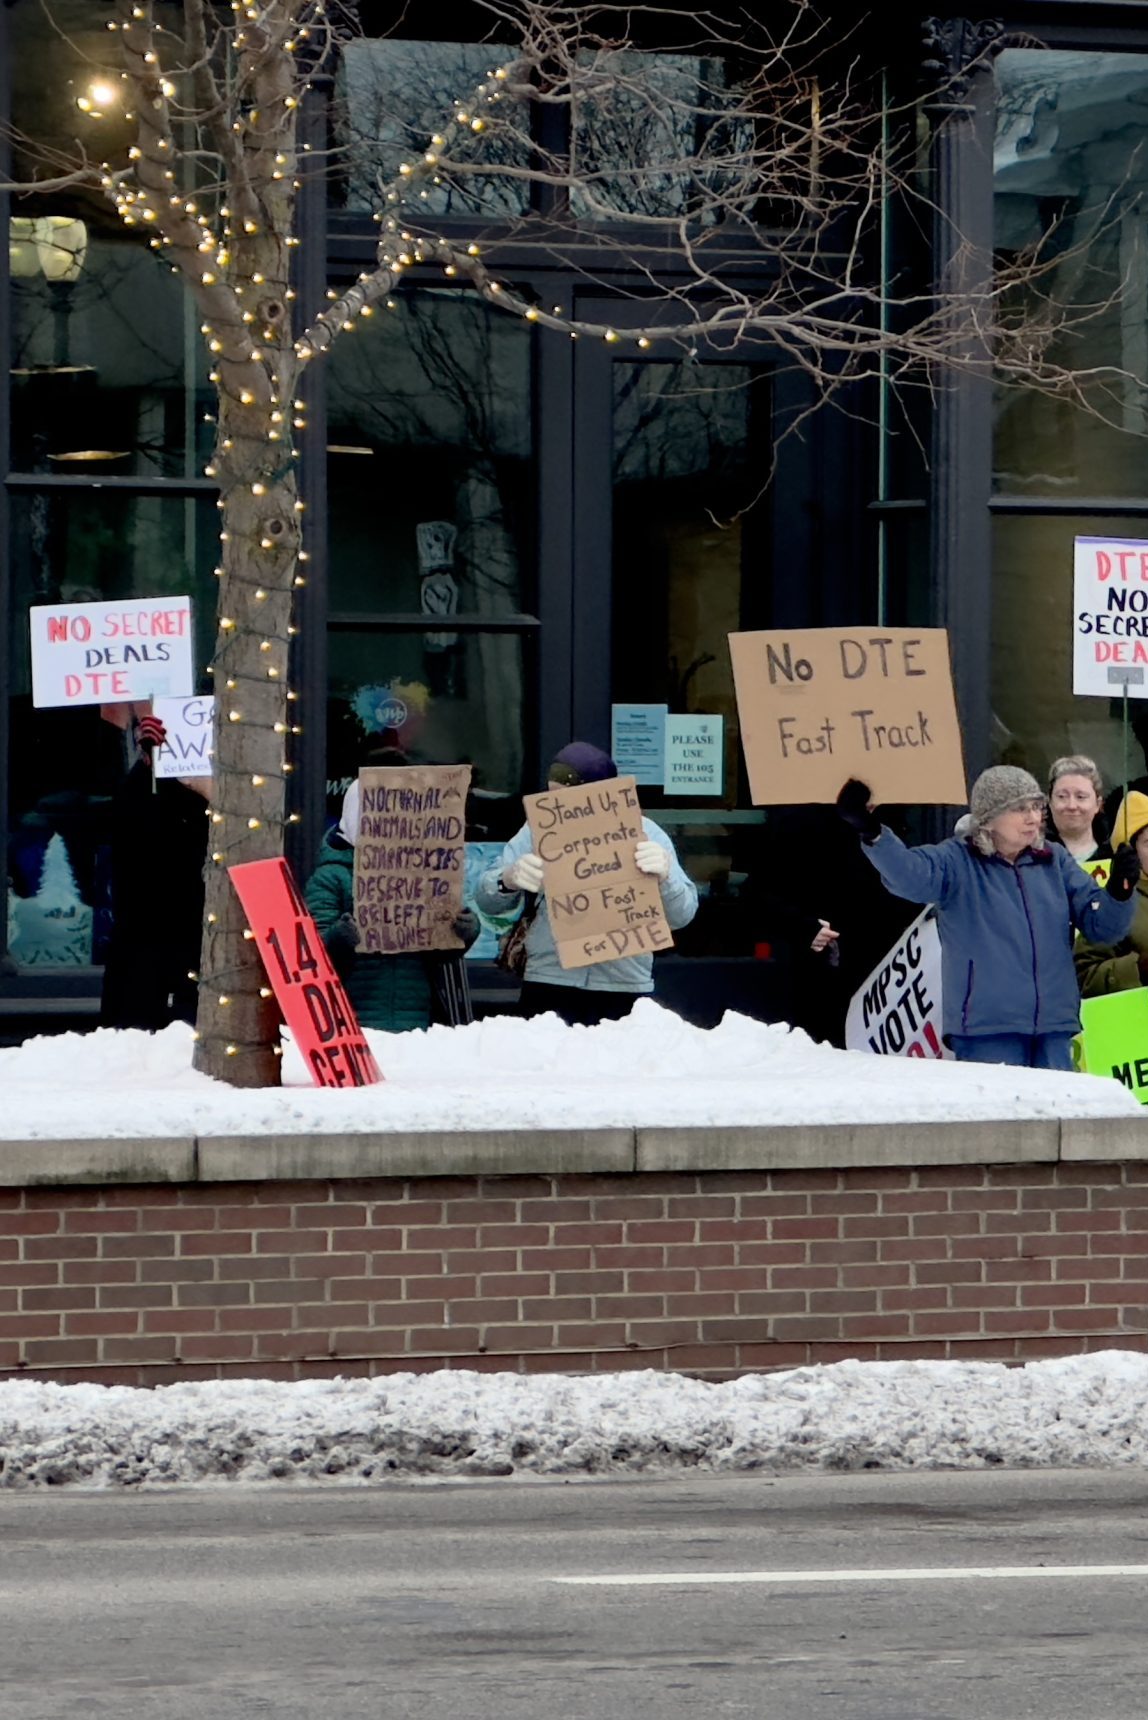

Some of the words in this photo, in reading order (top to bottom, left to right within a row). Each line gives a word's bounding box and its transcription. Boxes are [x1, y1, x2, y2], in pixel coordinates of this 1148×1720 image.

[1107, 587, 1148, 612] NO
[47, 615, 92, 643] NO
[102, 608, 189, 637] SECRET
[85, 641, 171, 669] DEALS
[766, 643, 813, 684] No
[840, 638, 926, 679] DTE
[64, 671, 131, 698] DTE
[672, 735, 714, 744] PLEASE
[778, 718, 835, 758] Fast
[852, 710, 932, 751] Track
[683, 750, 704, 758] USE
[672, 763, 693, 772] THE
[696, 764, 714, 773] 105
[536, 797, 595, 829] Stand
[599, 792, 618, 816] Up
[619, 788, 636, 807] To
[361, 816, 421, 840] ANIMALS
[424, 816, 461, 840] AND
[538, 822, 638, 862] Corporate
[574, 852, 622, 880] Greed
[356, 876, 422, 902] DESERVE
[428, 878, 449, 896] TO
[358, 904, 379, 927] BE
[383, 904, 424, 927] LEFT
[552, 893, 590, 919] NO
[618, 906, 660, 924] Track
[606, 922, 668, 955] DTE
[862, 927, 922, 1029] MPSC
[869, 970, 934, 1055] VOTE
